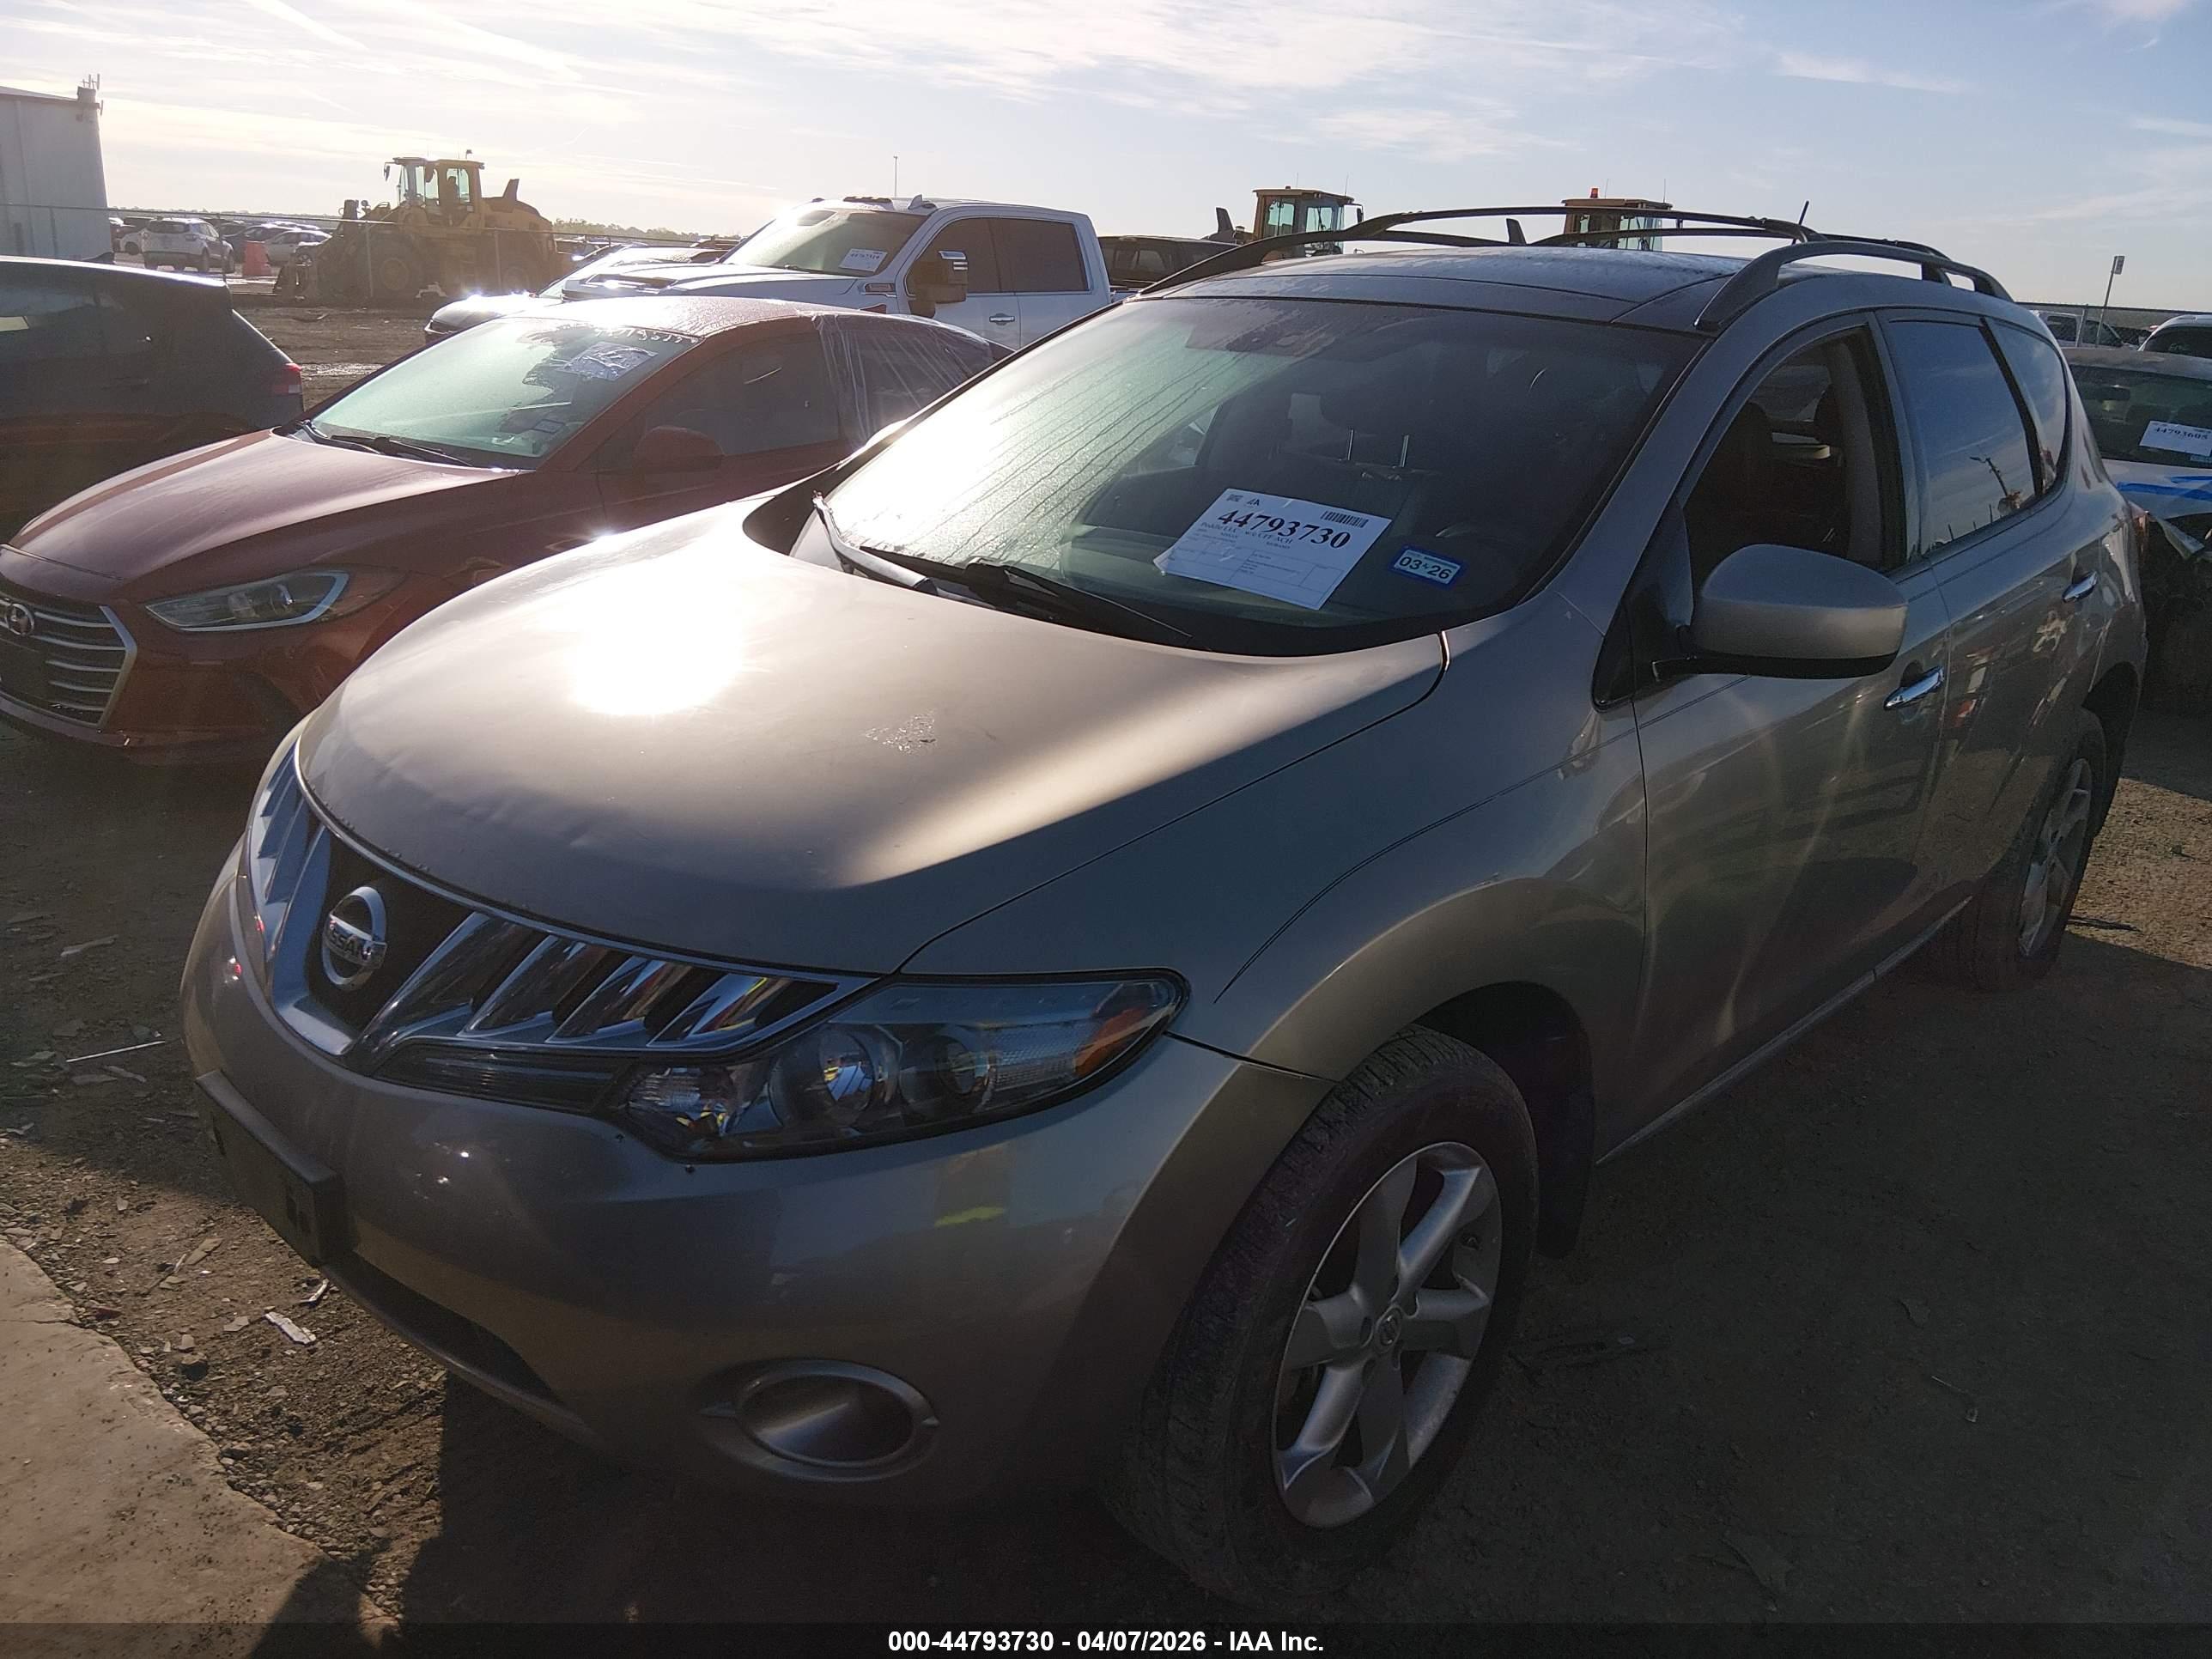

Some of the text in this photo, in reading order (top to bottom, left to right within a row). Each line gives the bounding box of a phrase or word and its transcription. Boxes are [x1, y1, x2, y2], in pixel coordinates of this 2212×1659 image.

[1218, 510, 1351, 549] 44793730
[1399, 556, 1423, 570] 03
[1426, 565, 1453, 580] 26
